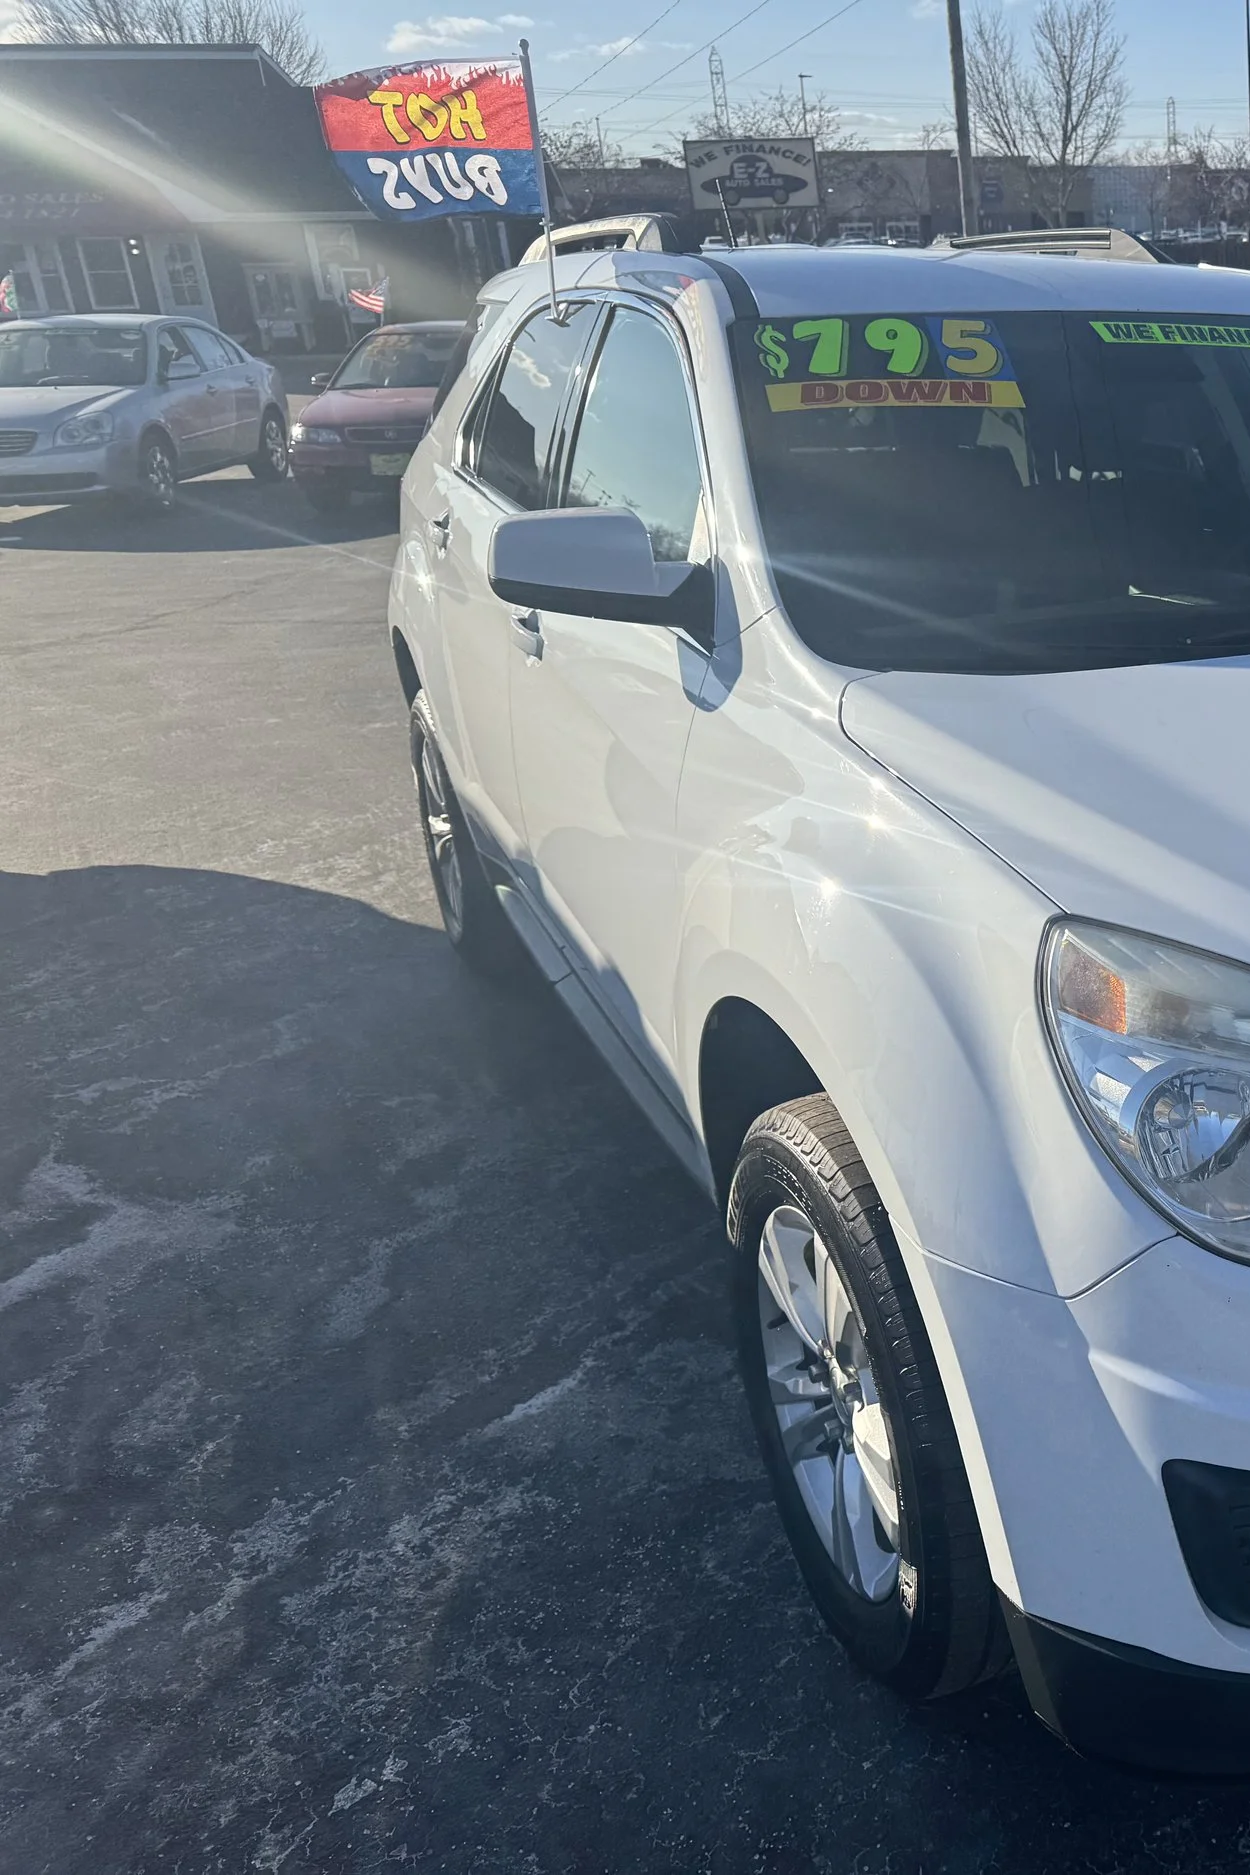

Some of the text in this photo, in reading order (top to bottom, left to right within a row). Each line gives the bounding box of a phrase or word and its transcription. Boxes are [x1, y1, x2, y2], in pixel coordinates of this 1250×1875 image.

[690, 143, 812, 169] WE FINANCE!
[732, 162, 770, 179] E-Z
[725, 177, 784, 188] AUTO SALES
[1103, 322, 1160, 342] WE
[753, 318, 1004, 379] $795
[800, 381, 992, 405] DOWN
